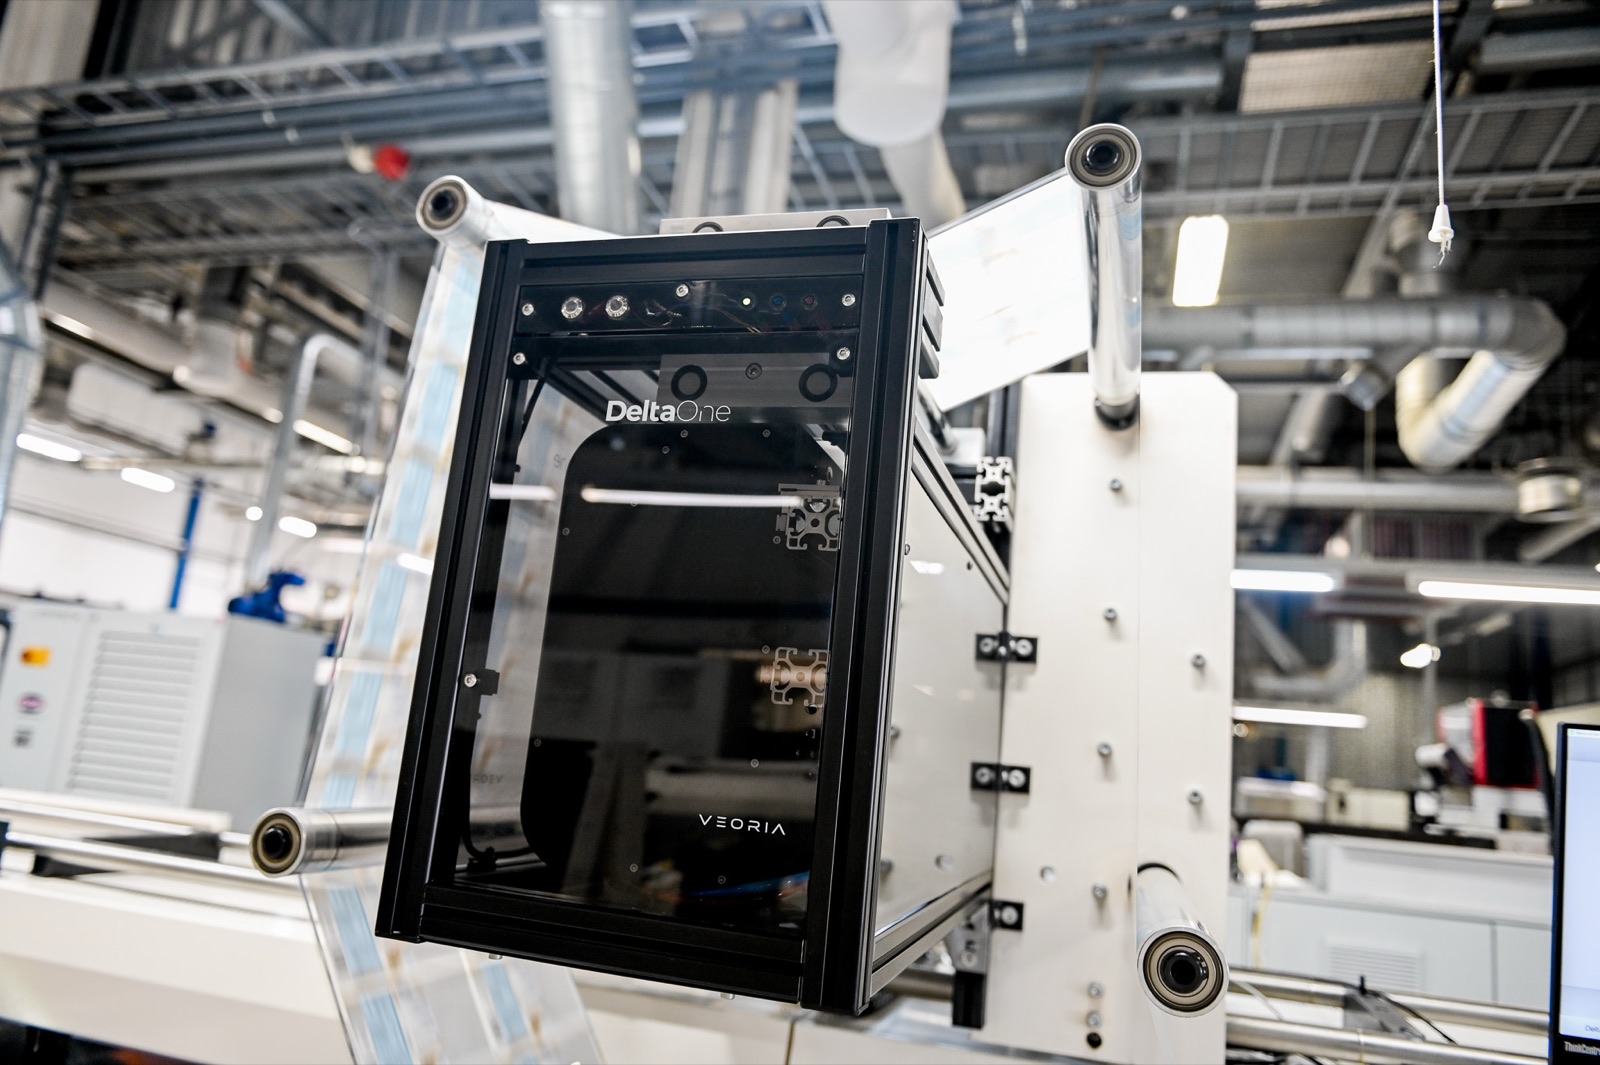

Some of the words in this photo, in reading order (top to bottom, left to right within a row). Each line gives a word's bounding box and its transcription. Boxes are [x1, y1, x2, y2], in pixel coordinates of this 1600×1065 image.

[605, 400, 731, 422] DeltaOne
[699, 813, 786, 836] VEORIA
[1564, 1040, 1600, 1056] ThinkCentr
